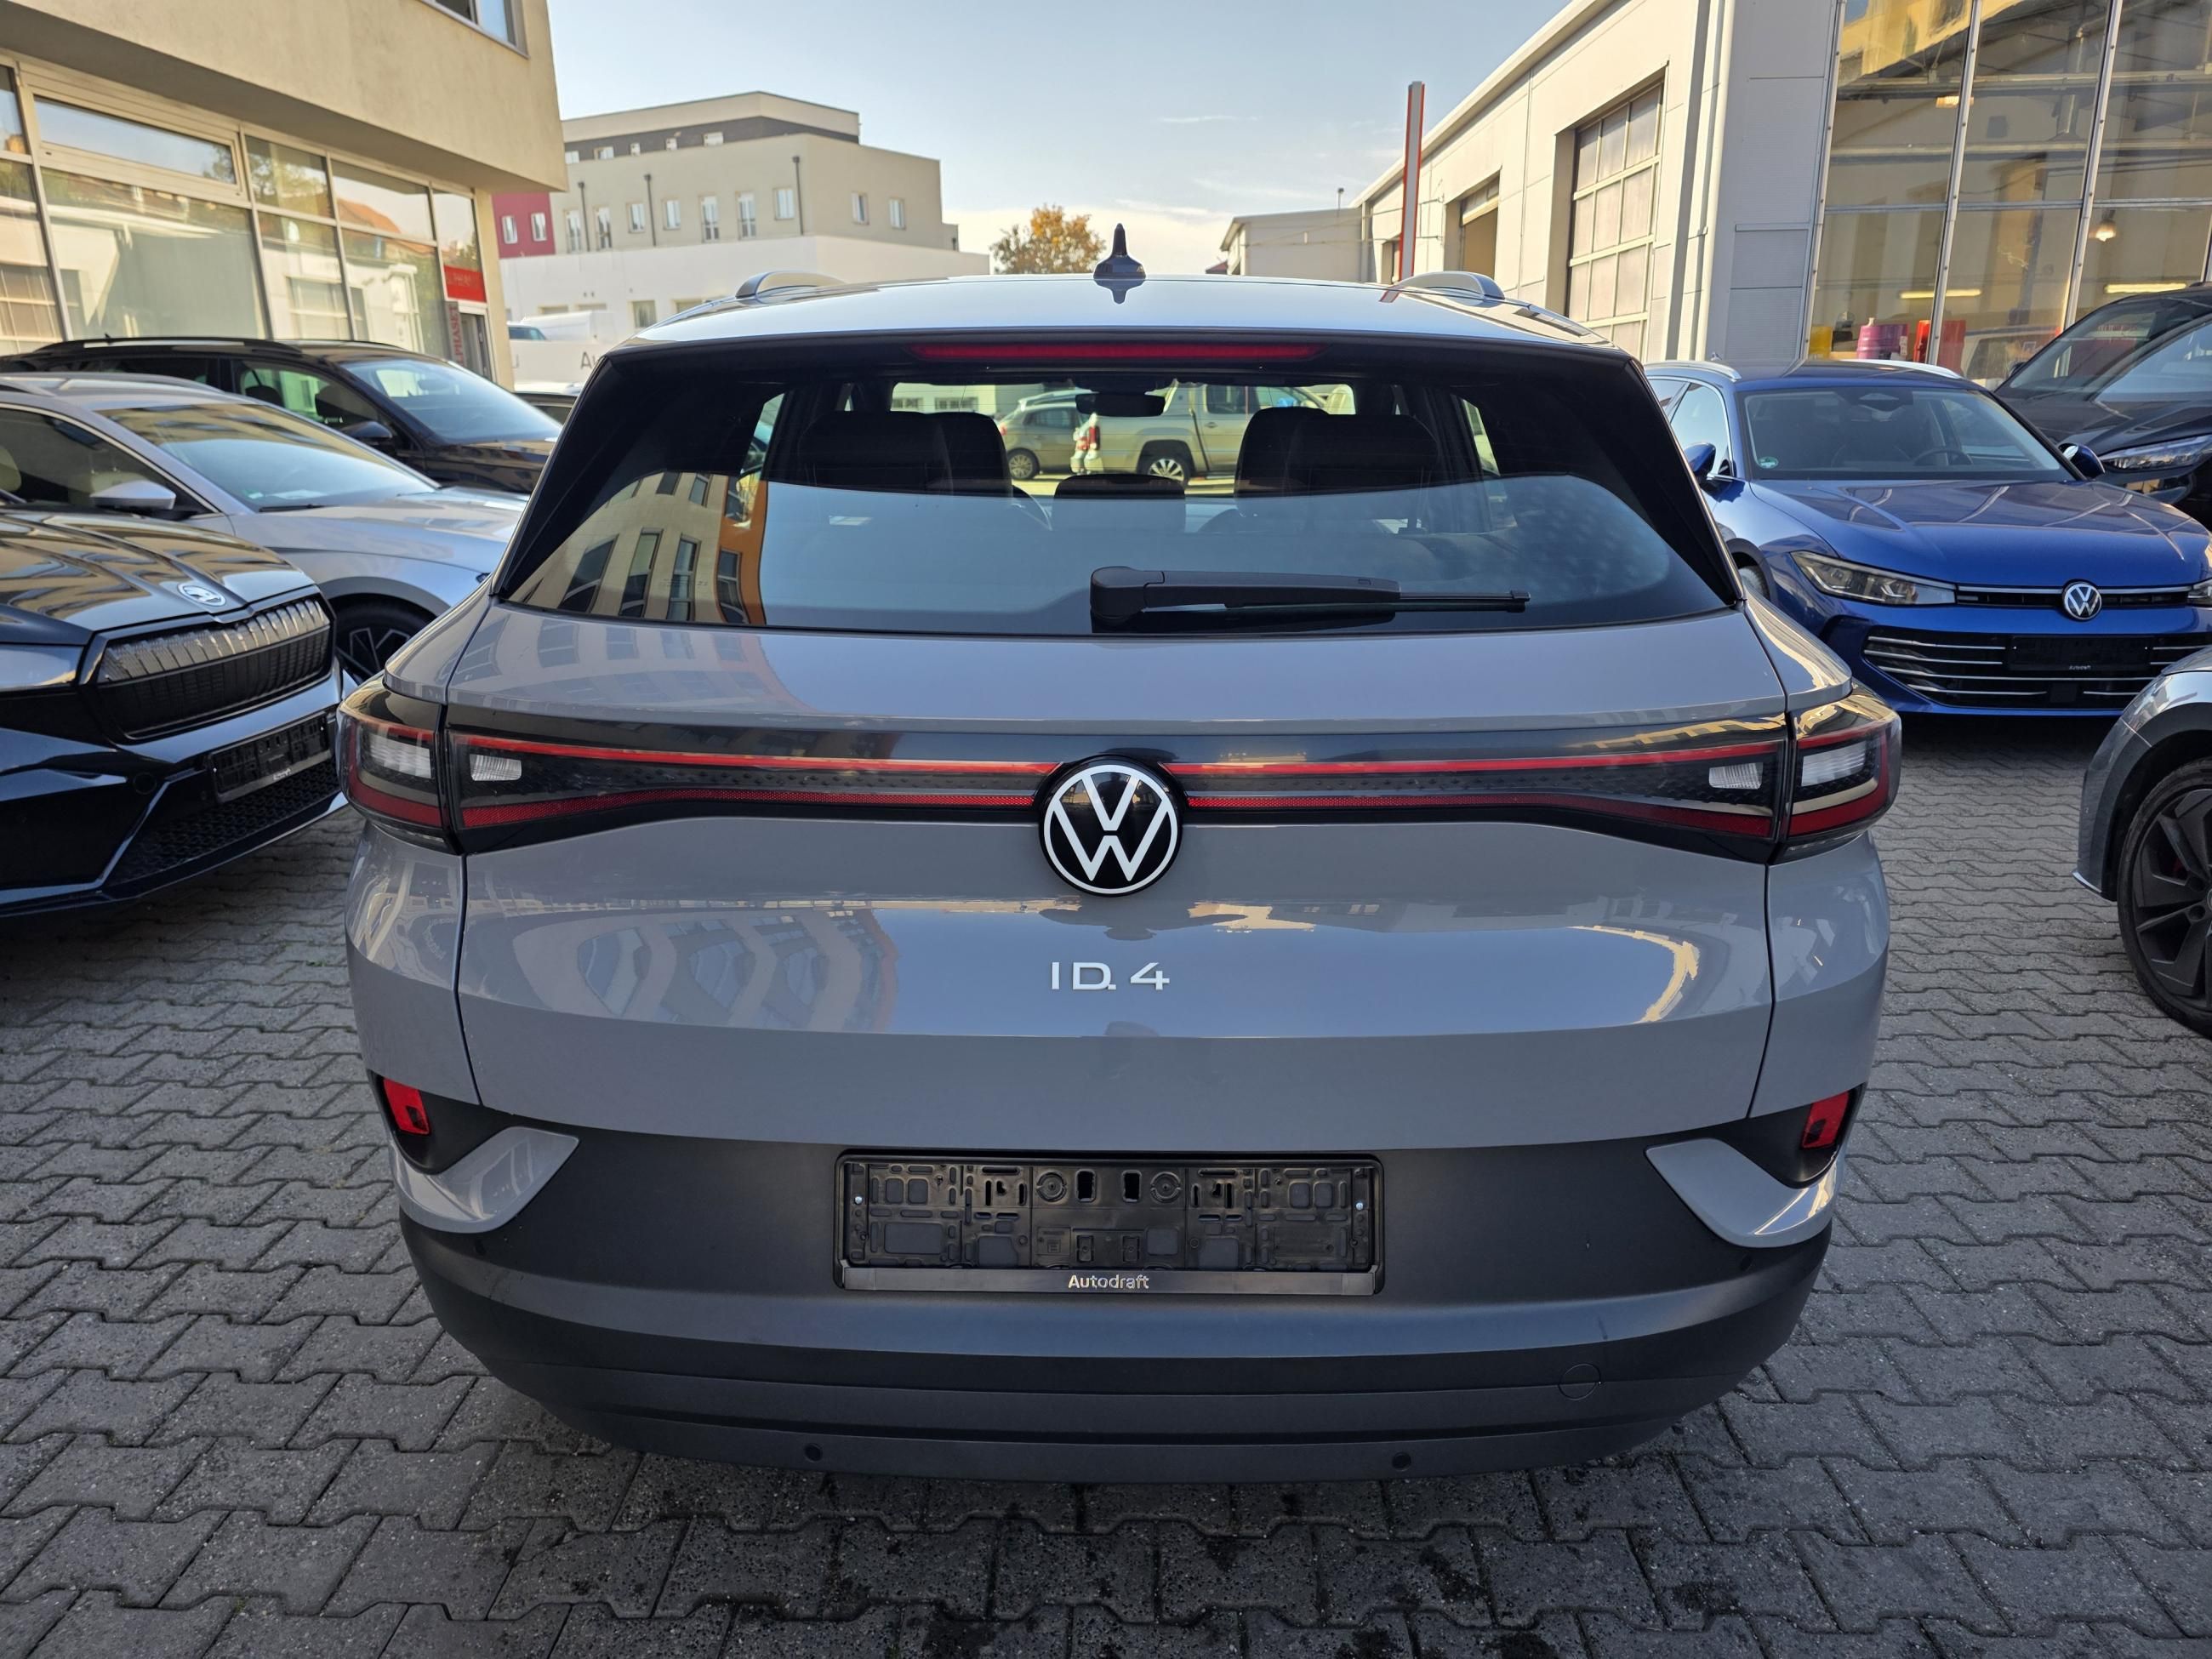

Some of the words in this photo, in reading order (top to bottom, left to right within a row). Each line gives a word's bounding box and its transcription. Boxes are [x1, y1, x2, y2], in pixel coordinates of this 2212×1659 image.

[2067, 584, 2100, 617] VW
[1050, 767, 1173, 885] VW
[1068, 1274, 1149, 1290] Autodraft
